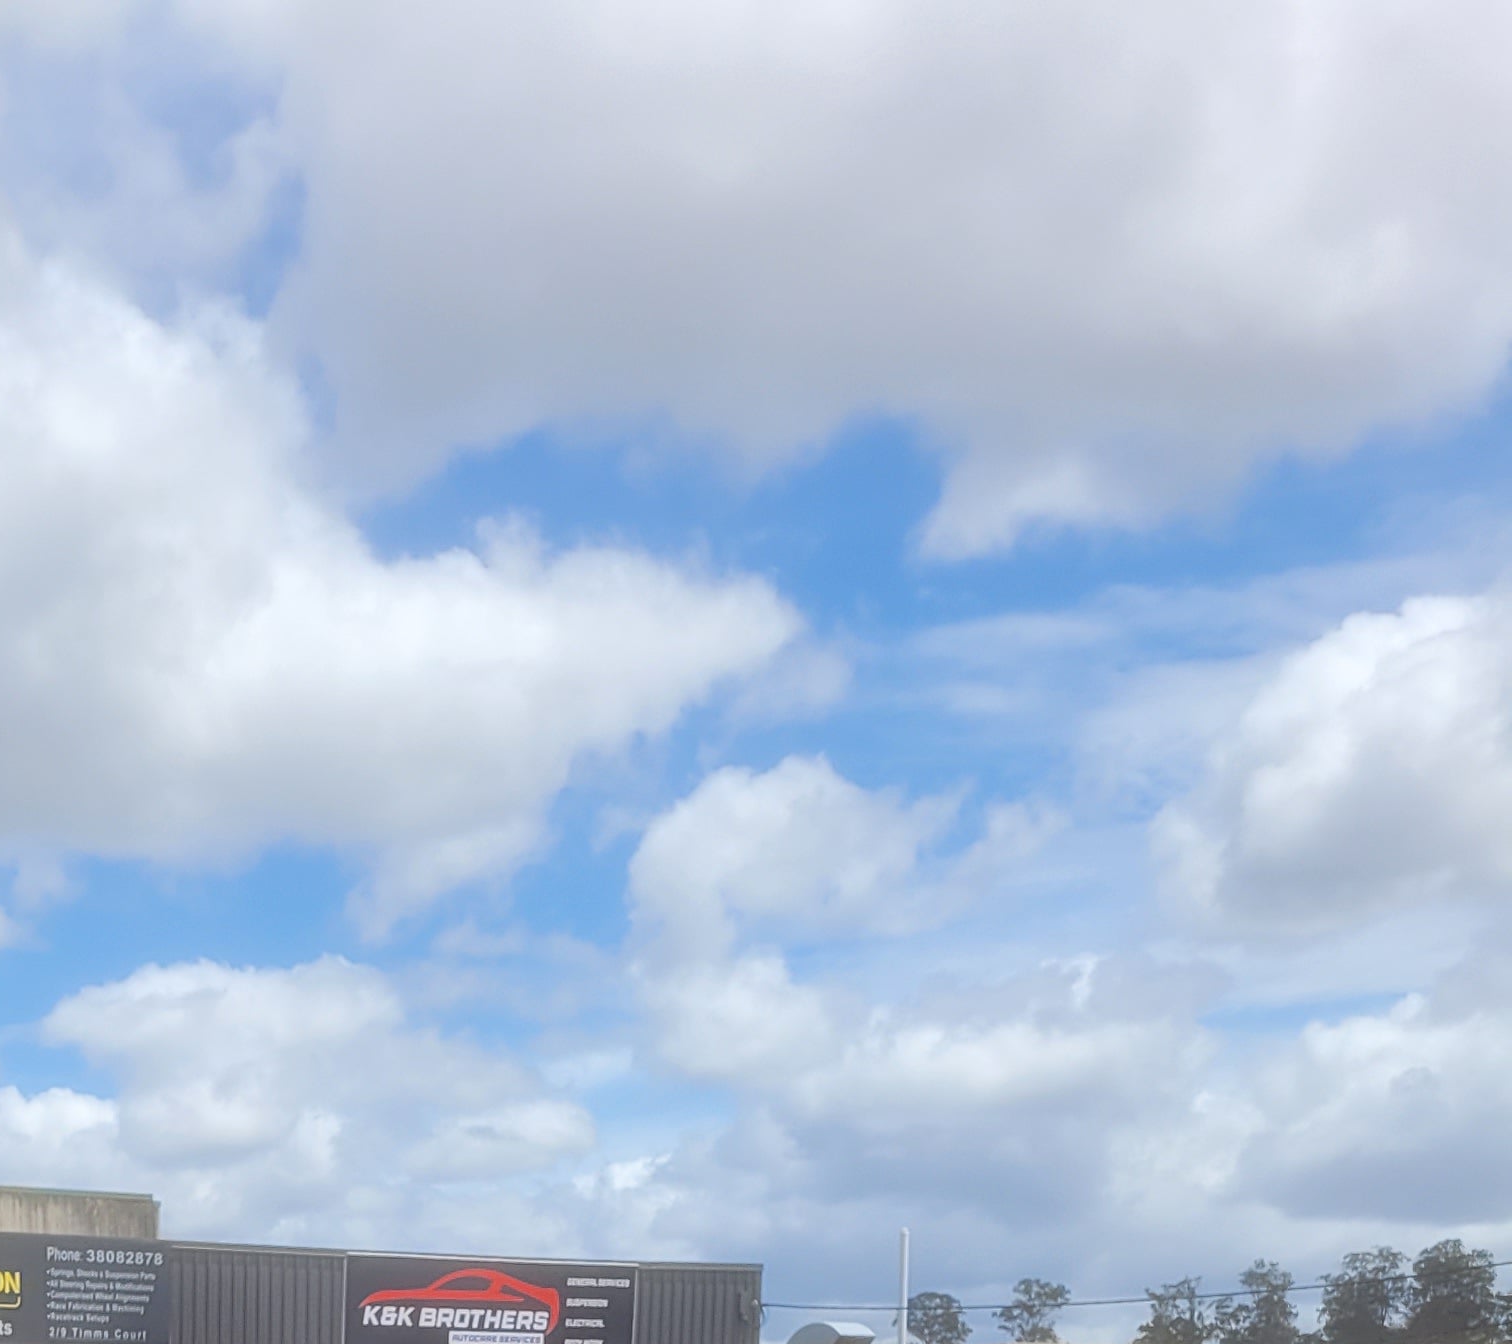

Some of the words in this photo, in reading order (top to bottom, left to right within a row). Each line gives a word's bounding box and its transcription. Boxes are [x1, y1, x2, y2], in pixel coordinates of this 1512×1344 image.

[86, 1249, 165, 1266] 38082878
[362, 1305, 416, 1327] K&K
[418, 1307, 550, 1331] BROTHERS
[72, 1328, 110, 1340] Timms
[114, 1329, 148, 1342] Court
[451, 1334, 498, 1343] AUTOCARE
[499, 1336, 542, 1344] SERVICES
